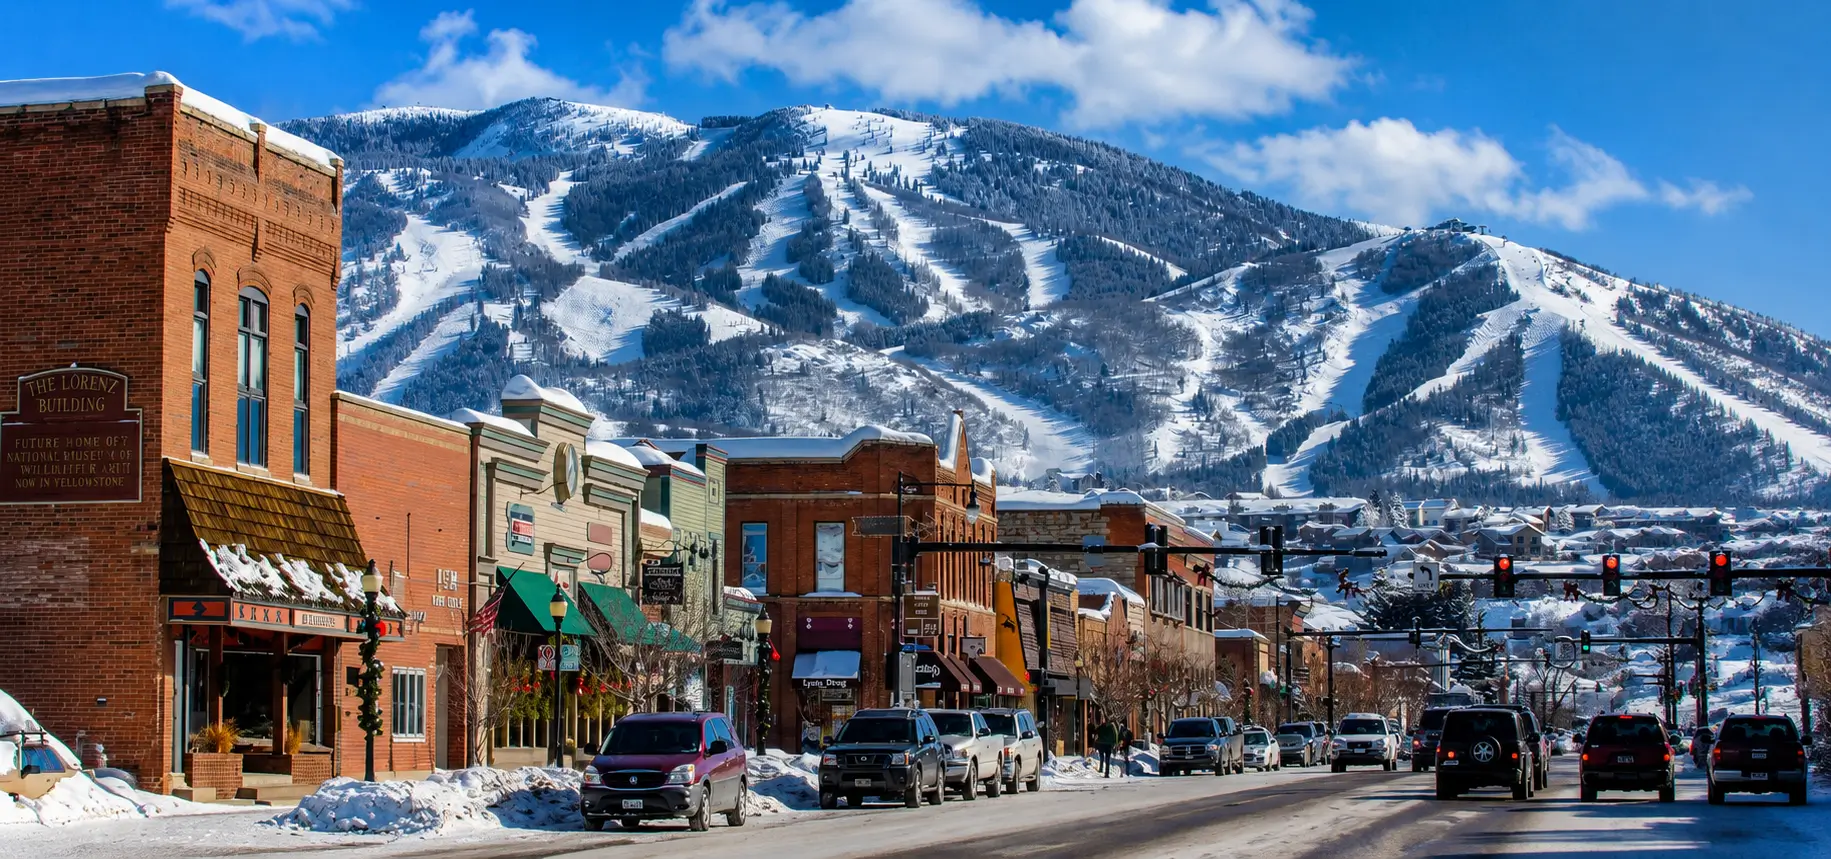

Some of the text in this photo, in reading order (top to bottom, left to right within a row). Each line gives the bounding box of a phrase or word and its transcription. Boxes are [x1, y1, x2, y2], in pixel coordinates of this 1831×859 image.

[25, 374, 120, 397] THE LORENZ
[38, 397, 105, 413] BUILDING
[15, 437, 60, 449] FUTURE
[66, 436, 100, 448] HOME
[7, 451, 60, 463] NATIONAL
[15, 476, 125, 489] NOW IN YELLOWSTONE
